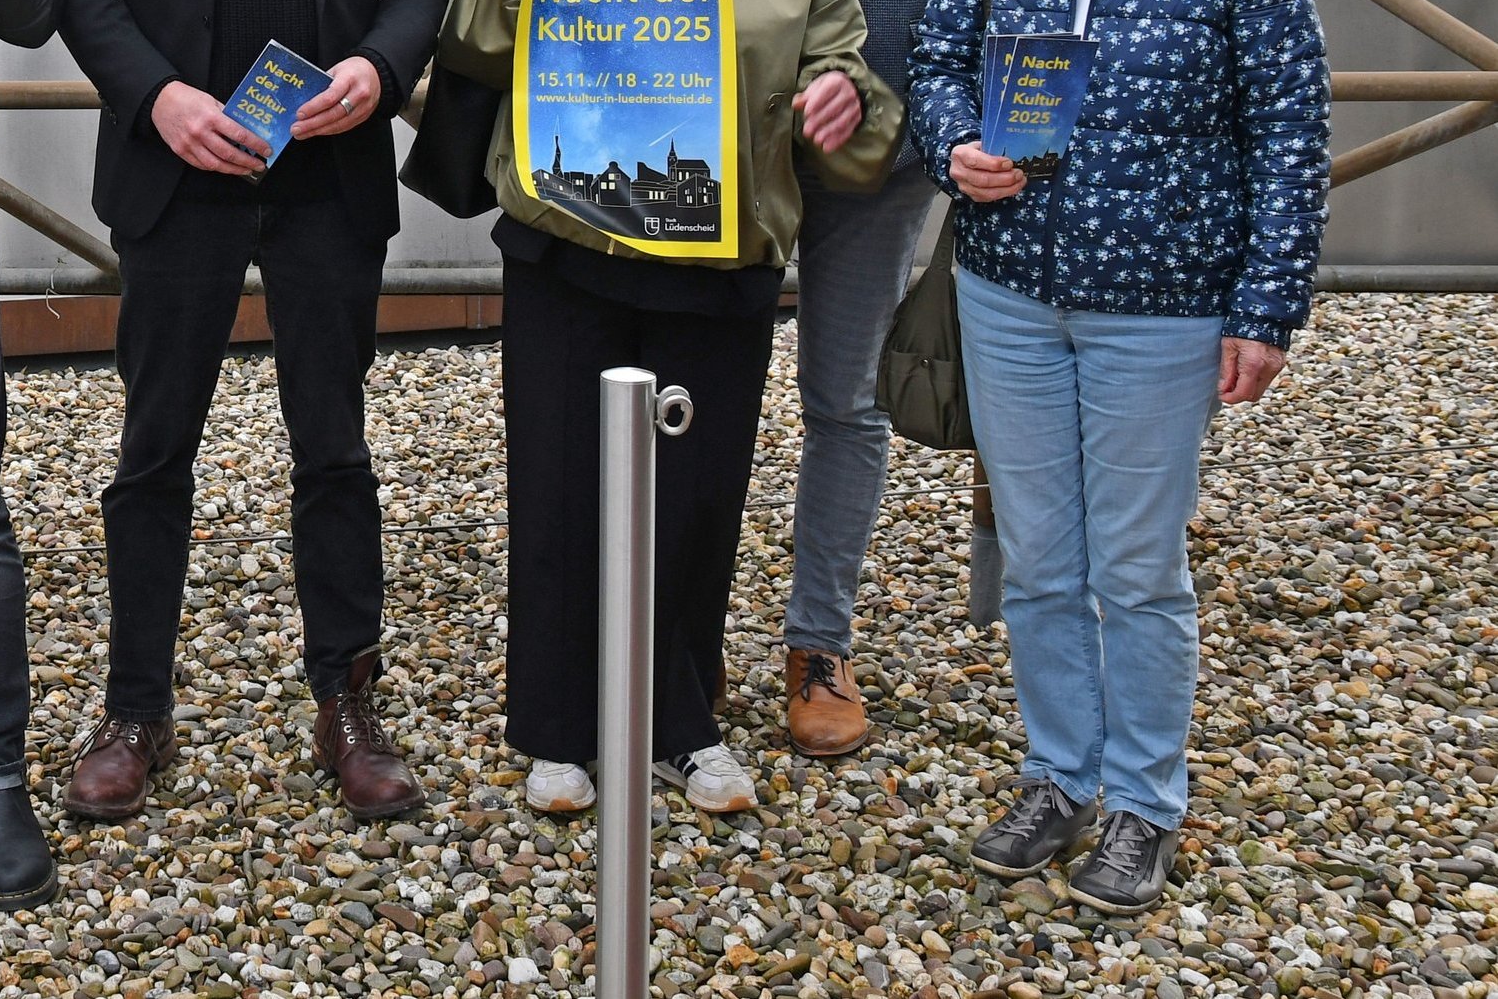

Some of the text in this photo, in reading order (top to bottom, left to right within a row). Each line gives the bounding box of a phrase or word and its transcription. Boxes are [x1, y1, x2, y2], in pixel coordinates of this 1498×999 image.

[537, 15, 712, 42] Kultur 2025
[1022, 56, 1072, 71] Nacht
[264, 60, 306, 90] Nacht
[537, 72, 591, 88] 15.11.
[595, 72, 610, 89] //
[615, 73, 637, 88] 18
[652, 73, 675, 88] 22
[680, 73, 713, 88] Uhr
[1017, 74, 1046, 87] der
[255, 75, 280, 92] der
[245, 85, 287, 115] Kultur
[536, 93, 713, 105] www.kultur-in-luedenscheid.de
[1013, 92, 1063, 107] Kultur
[236, 99, 274, 125] 2025
[1008, 110, 1051, 124] 2025
[664, 223, 715, 232] Lüdenscheid
